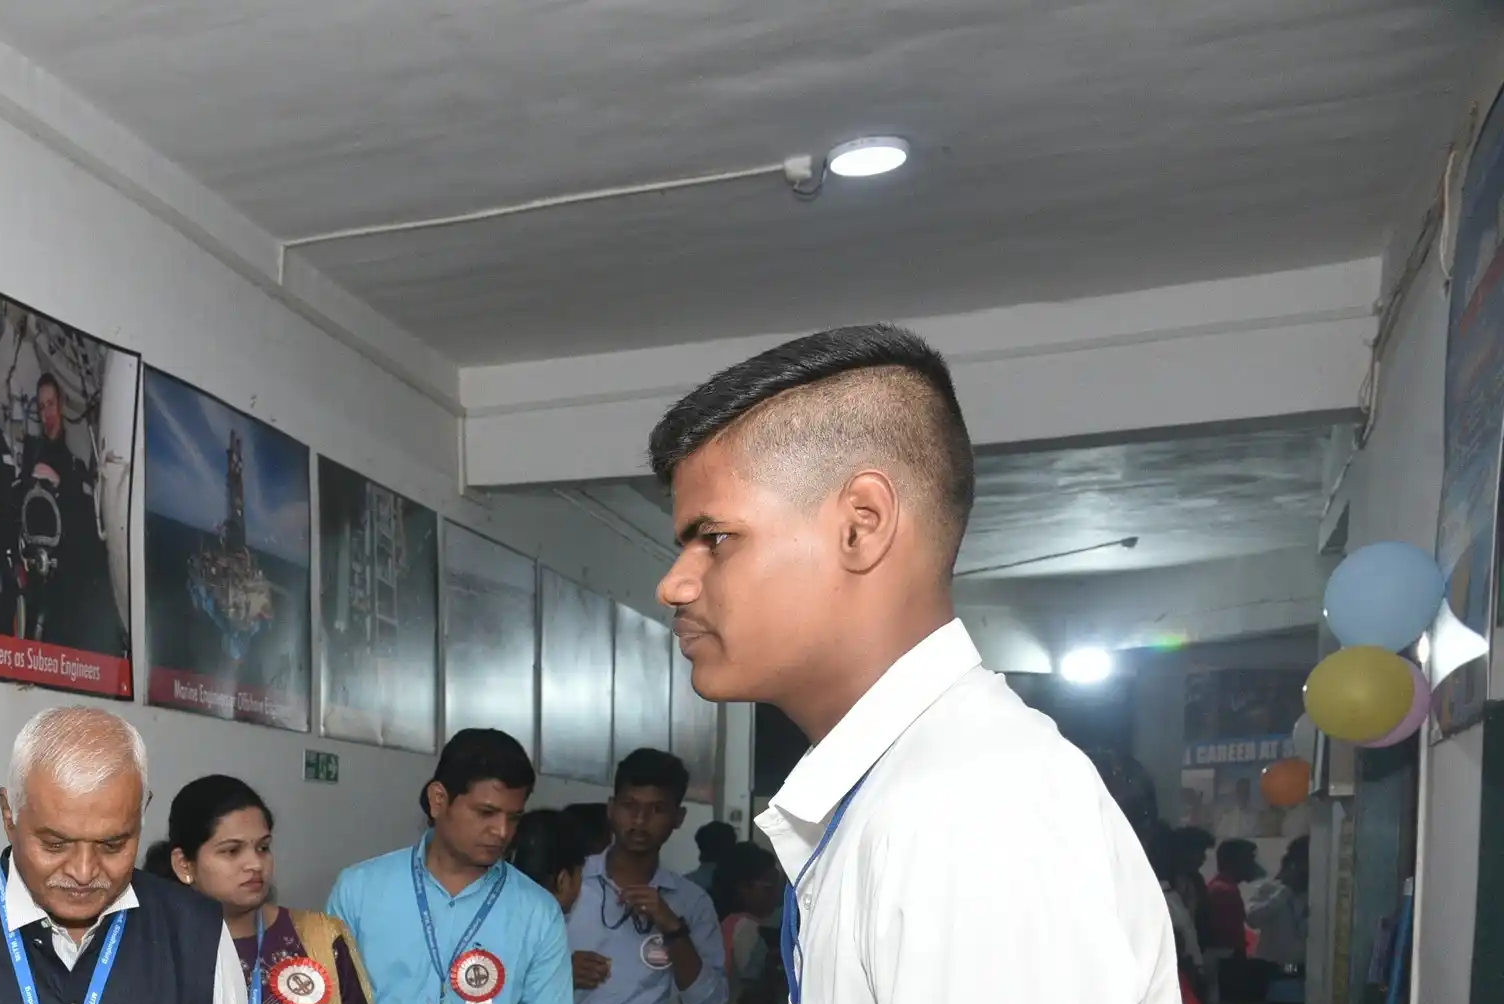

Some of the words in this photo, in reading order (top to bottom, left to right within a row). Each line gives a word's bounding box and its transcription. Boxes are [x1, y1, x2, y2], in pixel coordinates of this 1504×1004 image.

[14, 653, 25, 668] as
[27, 647, 58, 674] Subsea
[60, 653, 101, 682] Engineers
